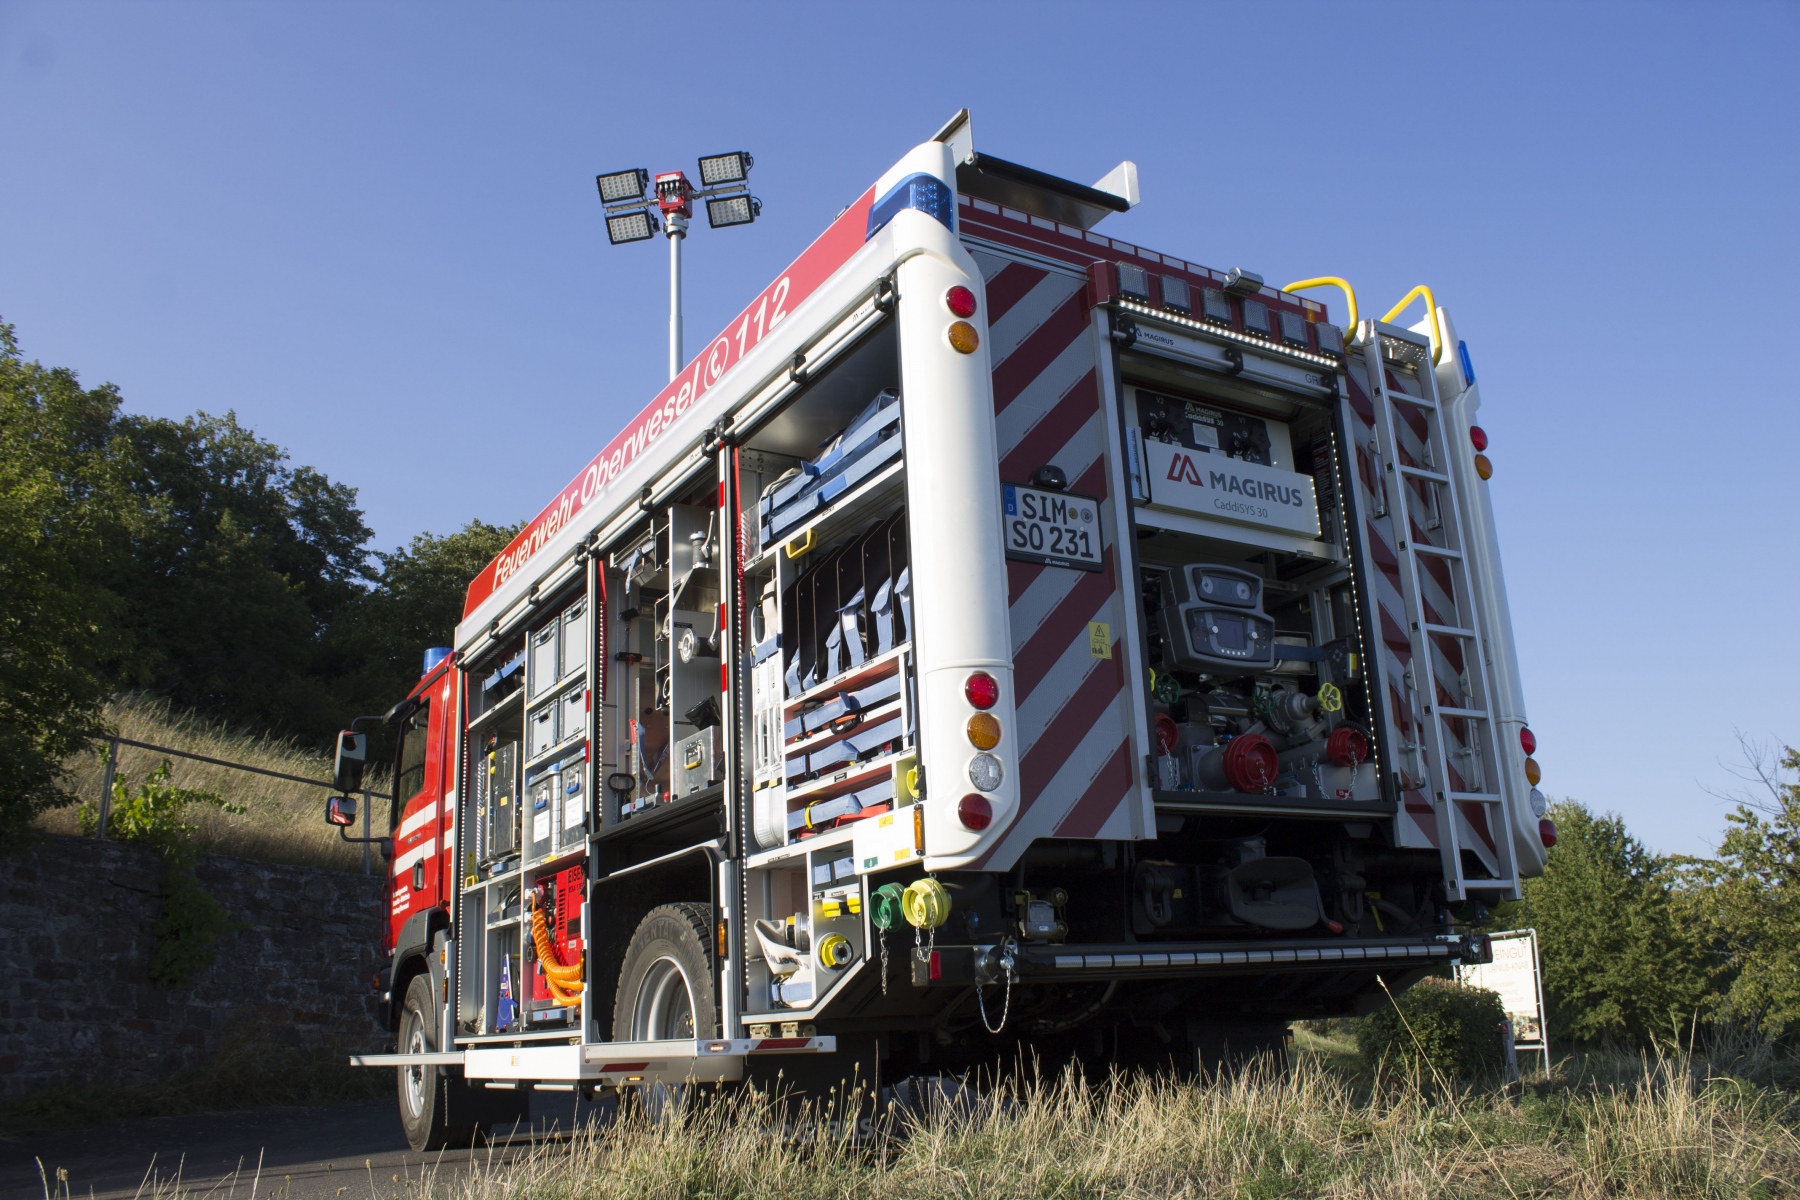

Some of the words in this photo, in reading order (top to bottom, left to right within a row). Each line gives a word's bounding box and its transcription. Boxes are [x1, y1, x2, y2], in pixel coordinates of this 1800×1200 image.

[1143, 332, 1174, 346] MAGIRUS
[492, 490, 579, 591] Feuerwehr
[580, 362, 700, 506] Oberwesel
[735, 276, 790, 360] 112
[1209, 470, 1303, 508] MAGIRUS
[1007, 503, 1014, 512] D
[1022, 493, 1068, 525] SIM
[1213, 498, 1255, 518] CaddiSYS
[1257, 506, 1269, 519] 30
[1013, 520, 1044, 551] SO
[1049, 526, 1094, 559] 231
[1493, 945, 1527, 961] EINGUT
